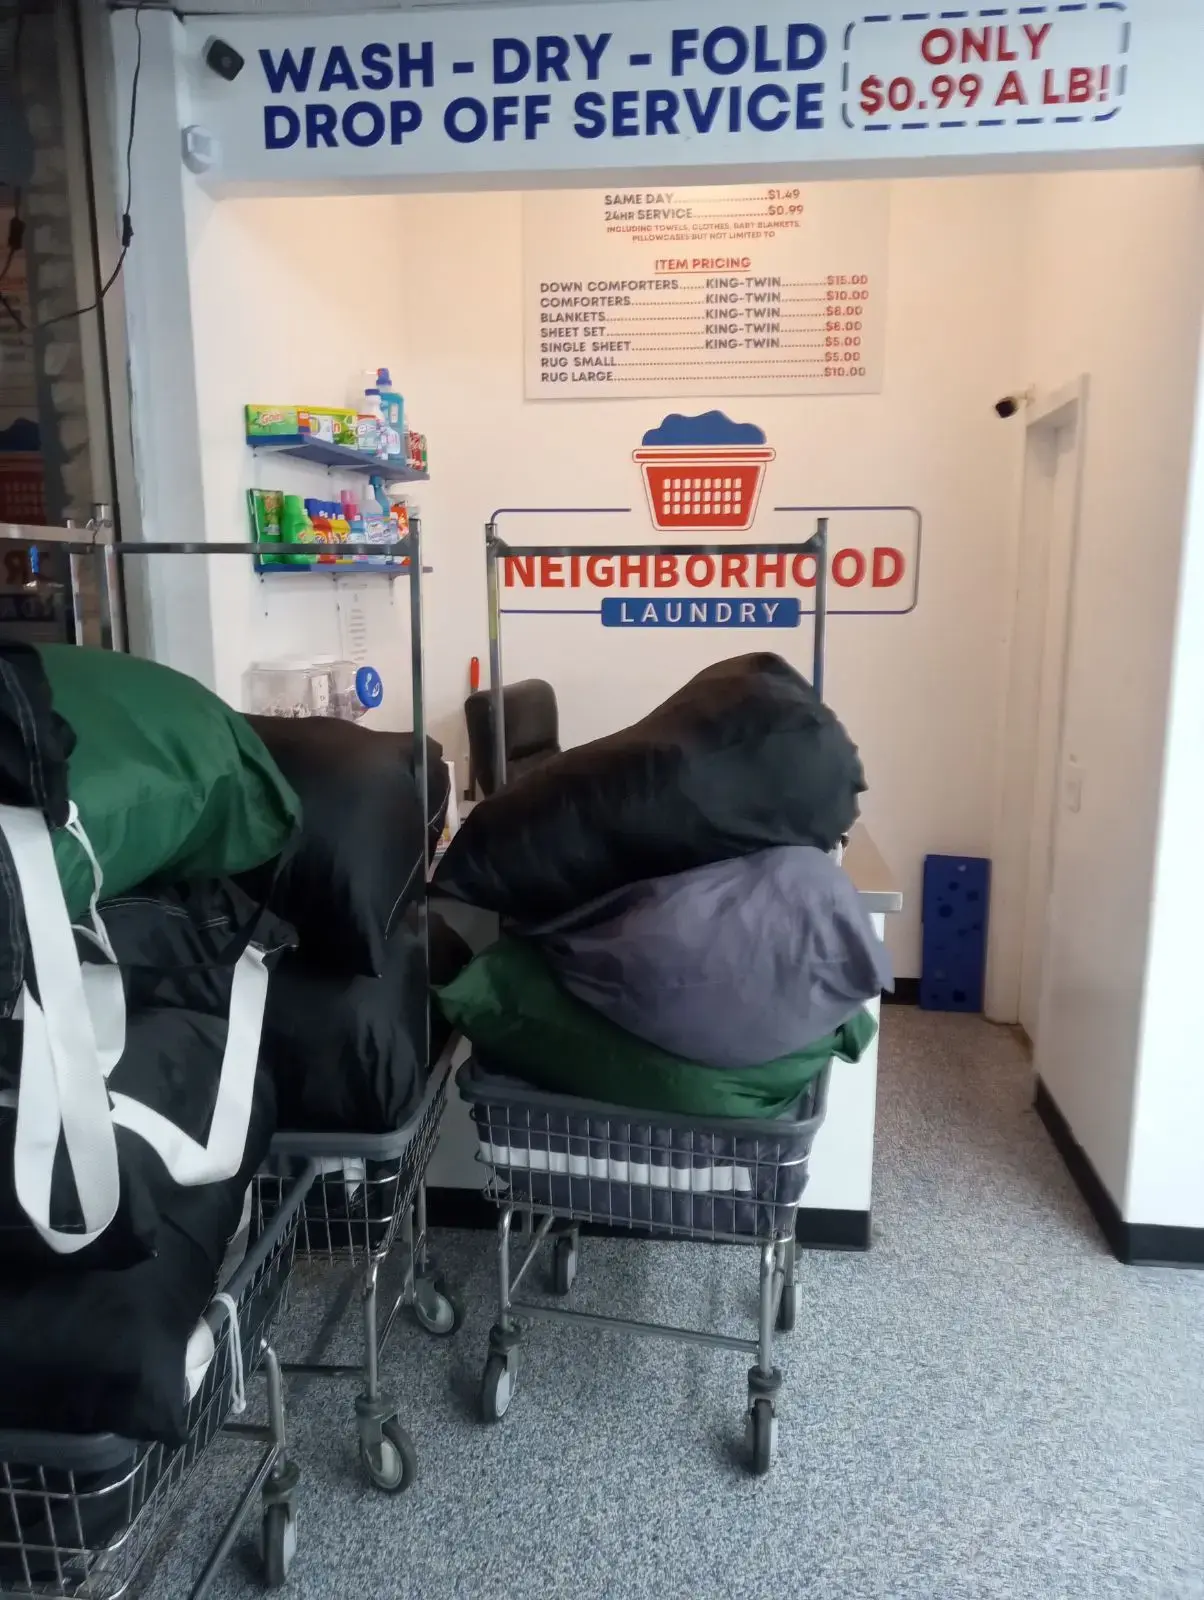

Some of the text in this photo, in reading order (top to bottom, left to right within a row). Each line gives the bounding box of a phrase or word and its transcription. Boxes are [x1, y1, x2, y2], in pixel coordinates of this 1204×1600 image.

[921, 23, 1053, 66] ONLY
[258, 41, 434, 94] WASH
[492, 33, 613, 85] DRY
[671, 23, 827, 77] FOLD
[859, 64, 1111, 116] $0.99 A LB!
[264, 82, 825, 150] DROP OFF SERVICE
[604, 189, 800, 206] SAME DAY $1.49
[604, 205, 804, 221] 24HR SERVICE $0.99
[607, 225, 652, 233] INCLUDING
[691, 232, 707, 240] BUT
[709, 232, 727, 240] NOT
[729, 231, 761, 239] LIMITED
[655, 257, 751, 270] ITEM PRICING
[540, 281, 582, 293] DOWN
[587, 279, 679, 292] COMFORTERS
[705, 277, 781, 289] KING-TWIN
[540, 290, 869, 308] COMFORTERS KING-TWIN $10.00
[540, 312, 606, 323] BLANKETS
[705, 307, 781, 319] KING-TWIN
[540, 327, 579, 338] SHEET
[583, 326, 606, 337] SET
[705, 323, 780, 334] KING-TWIN
[540, 336, 861, 353] SINGLE SHEET KING-TWIN $5.00
[541, 357, 568, 368] RUG
[573, 356, 617, 367] SMALL
[541, 372, 568, 383] RUG
[571, 371, 613, 382] LARGE
[503, 547, 907, 588] NEIGHBORHOOD
[620, 602, 780, 624] LAUNDRY
